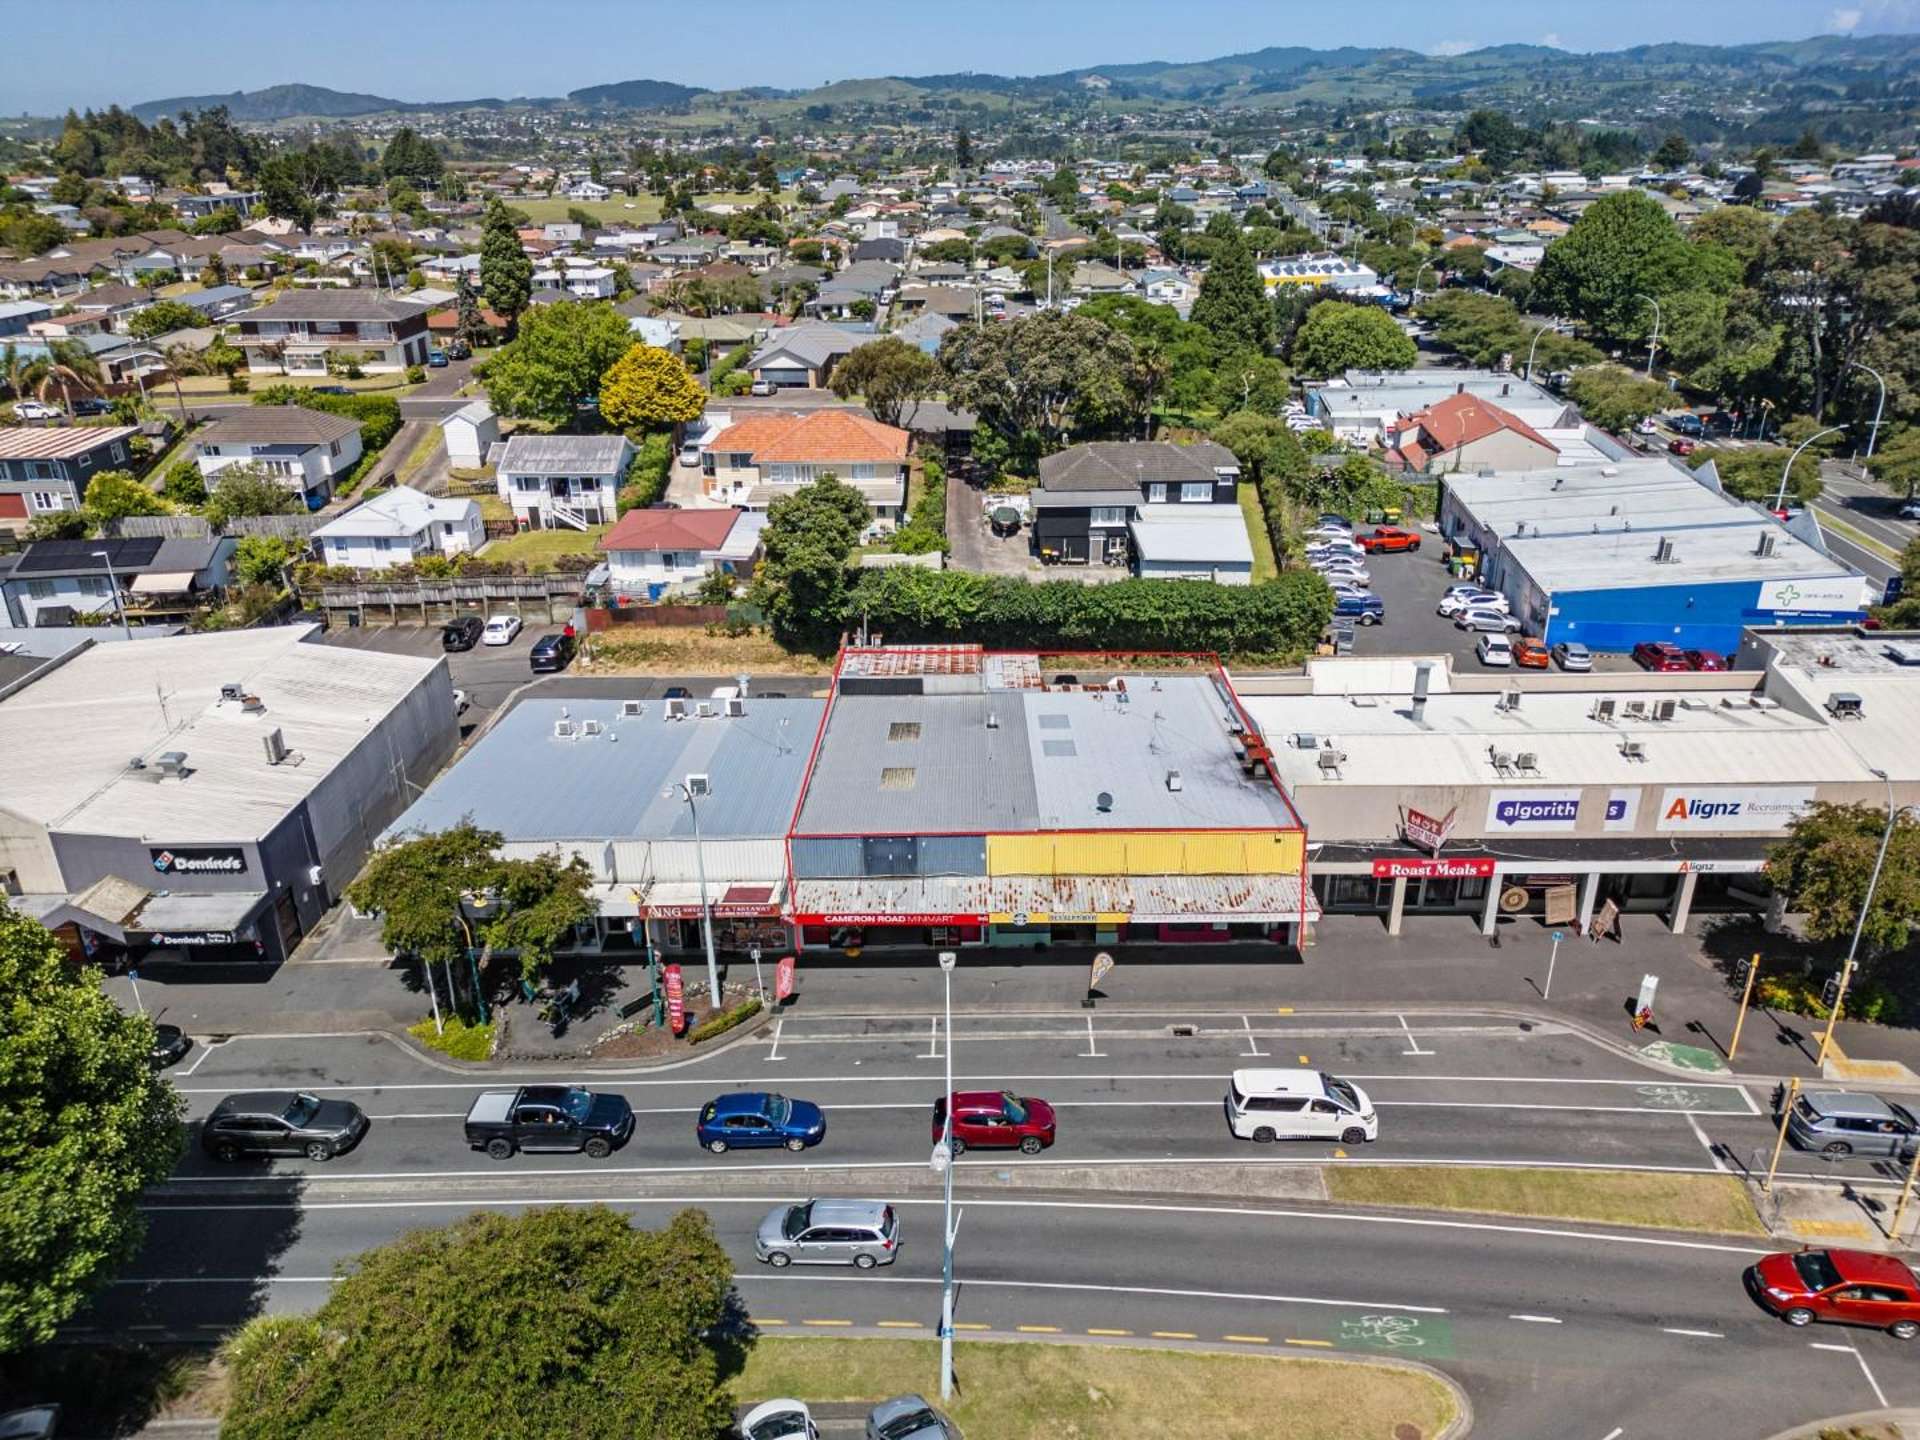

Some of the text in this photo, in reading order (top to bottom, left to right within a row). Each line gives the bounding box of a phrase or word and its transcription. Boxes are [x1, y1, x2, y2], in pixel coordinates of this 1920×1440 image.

[1503, 802, 1618, 819] algorith s
[1665, 798, 1741, 819] Alignz
[1389, 864, 1478, 876] Roast Meals
[1679, 861, 1714, 873] Alignz
[824, 914, 954, 923] CAMERON ROAD MINIMART
